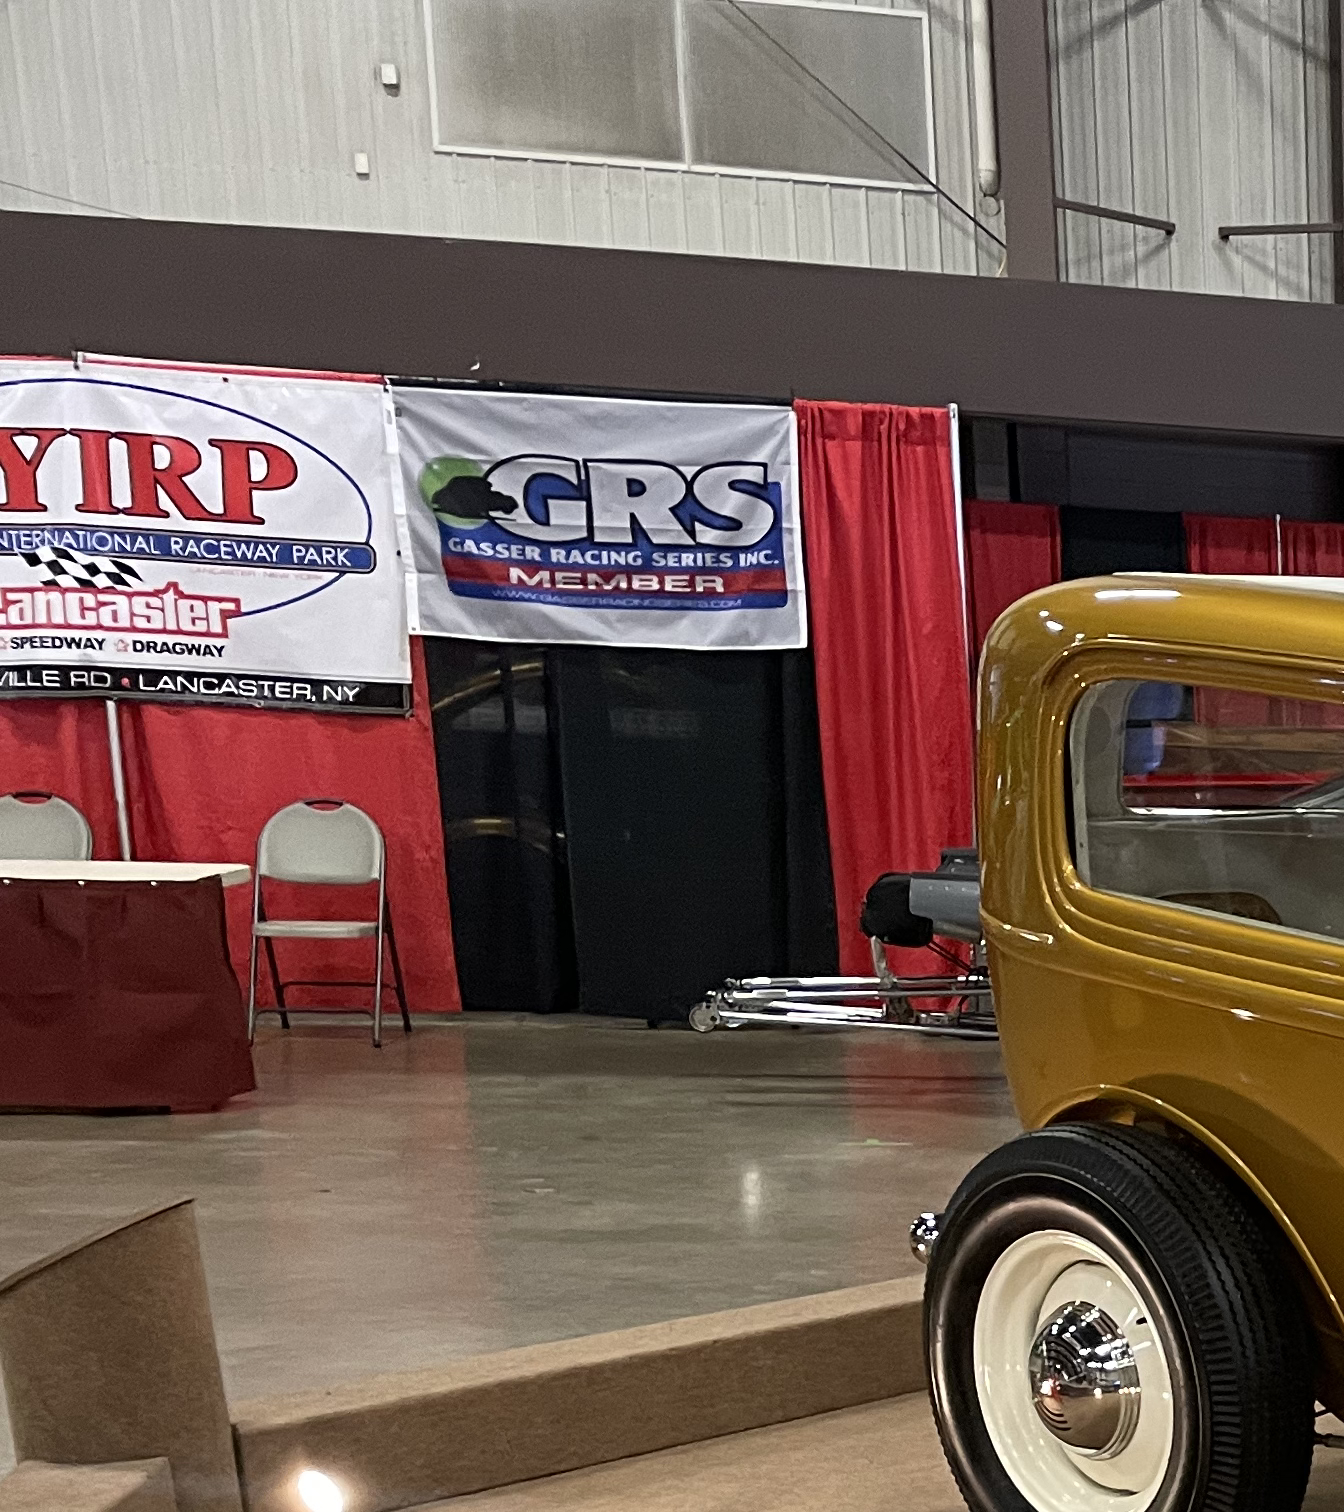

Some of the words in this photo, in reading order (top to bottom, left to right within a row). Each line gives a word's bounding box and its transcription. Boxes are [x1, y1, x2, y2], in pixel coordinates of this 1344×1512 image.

[484, 454, 776, 548] GRS
[170, 537, 280, 562] RACEWAY
[292, 545, 351, 567] PARK
[448, 537, 542, 561] GASSER
[550, 547, 643, 565] RACING
[651, 552, 734, 568] SERIES
[739, 550, 780, 567] INC.
[508, 567, 725, 593] MEMBER
[10, 635, 107, 650] SPEEDWAY
[132, 640, 226, 658] DRAGWAY
[70, 671, 111, 688] RD
[139, 673, 316, 701] LANCASTER,
[323, 685, 360, 701] NY
